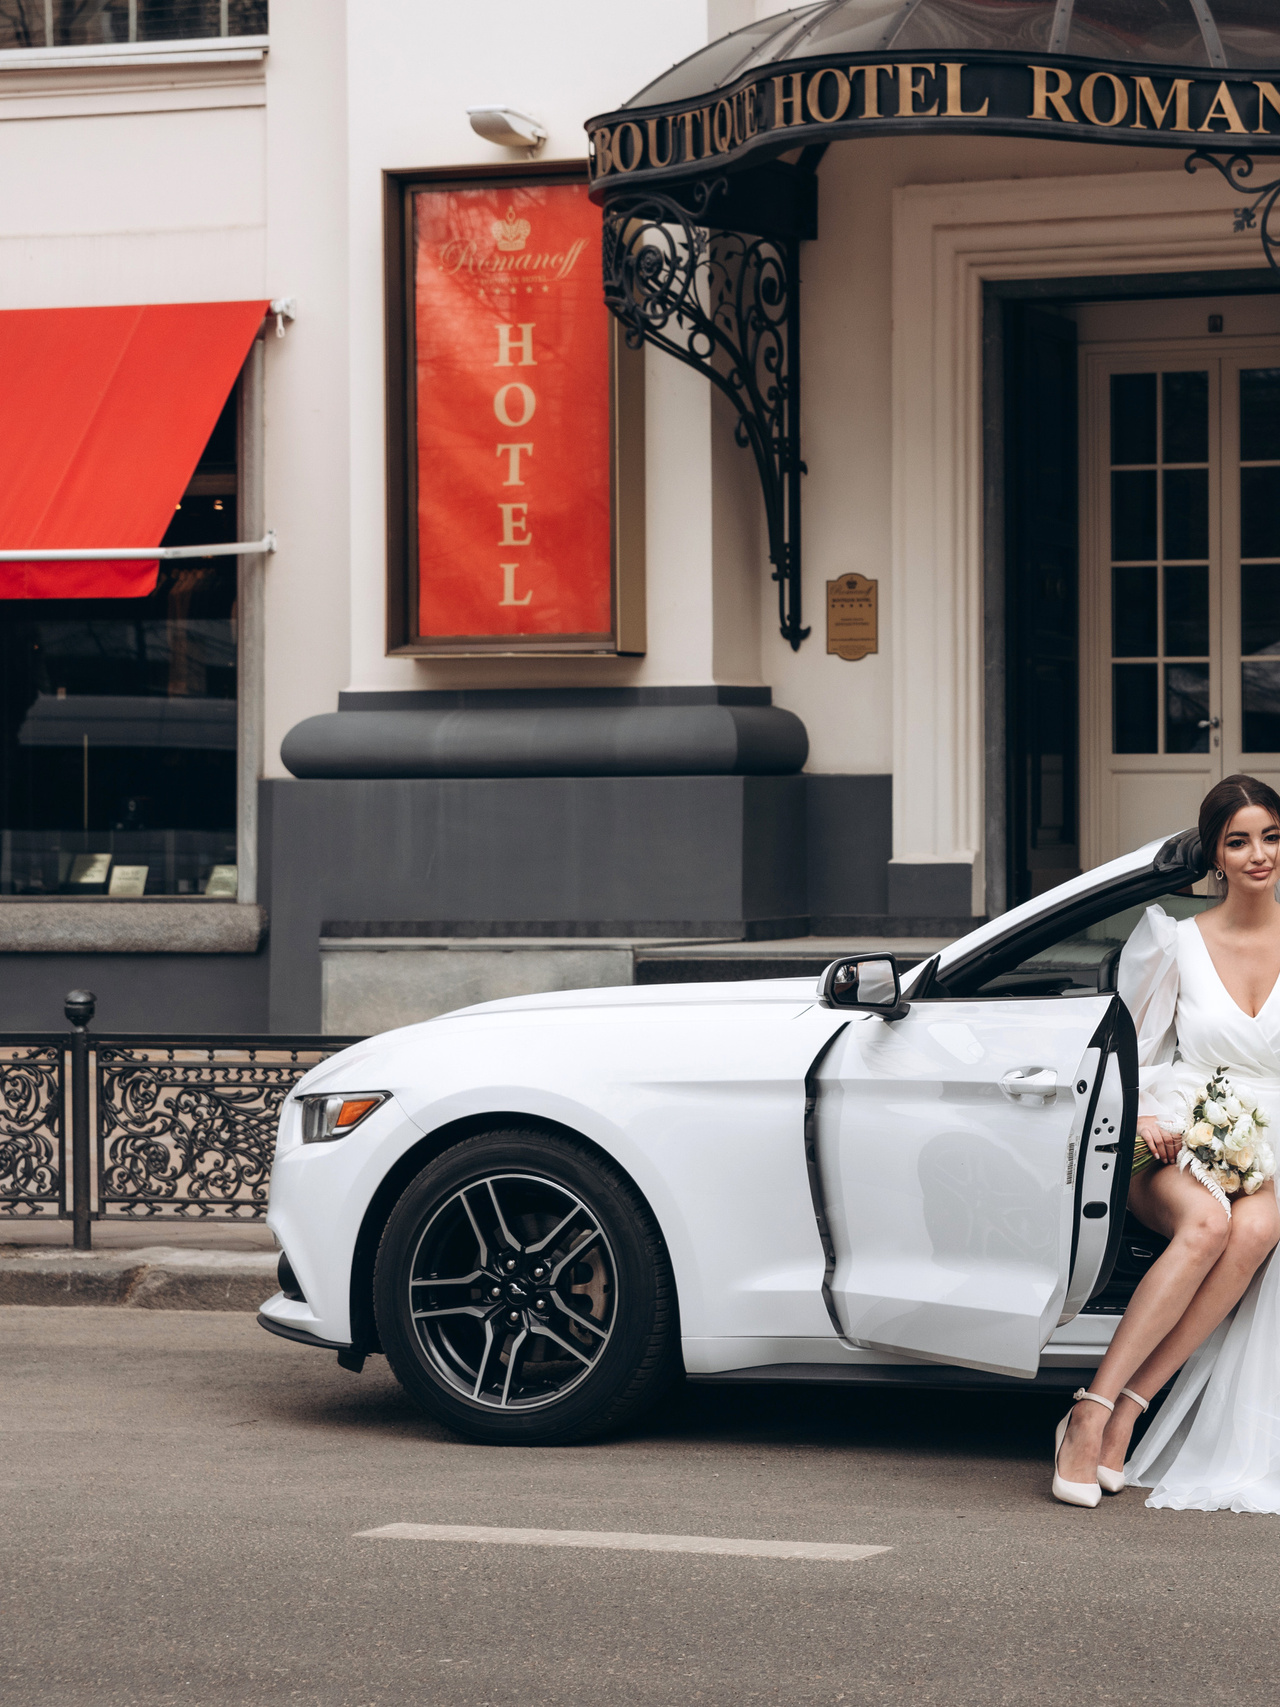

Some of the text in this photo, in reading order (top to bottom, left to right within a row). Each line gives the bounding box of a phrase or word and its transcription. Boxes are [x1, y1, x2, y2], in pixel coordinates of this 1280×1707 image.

[594, 83, 758, 179] BOUTIQUE
[770, 62, 989, 130] HOTEL
[438, 237, 591, 280] Romanoff
[493, 322, 538, 606] HOTEL
